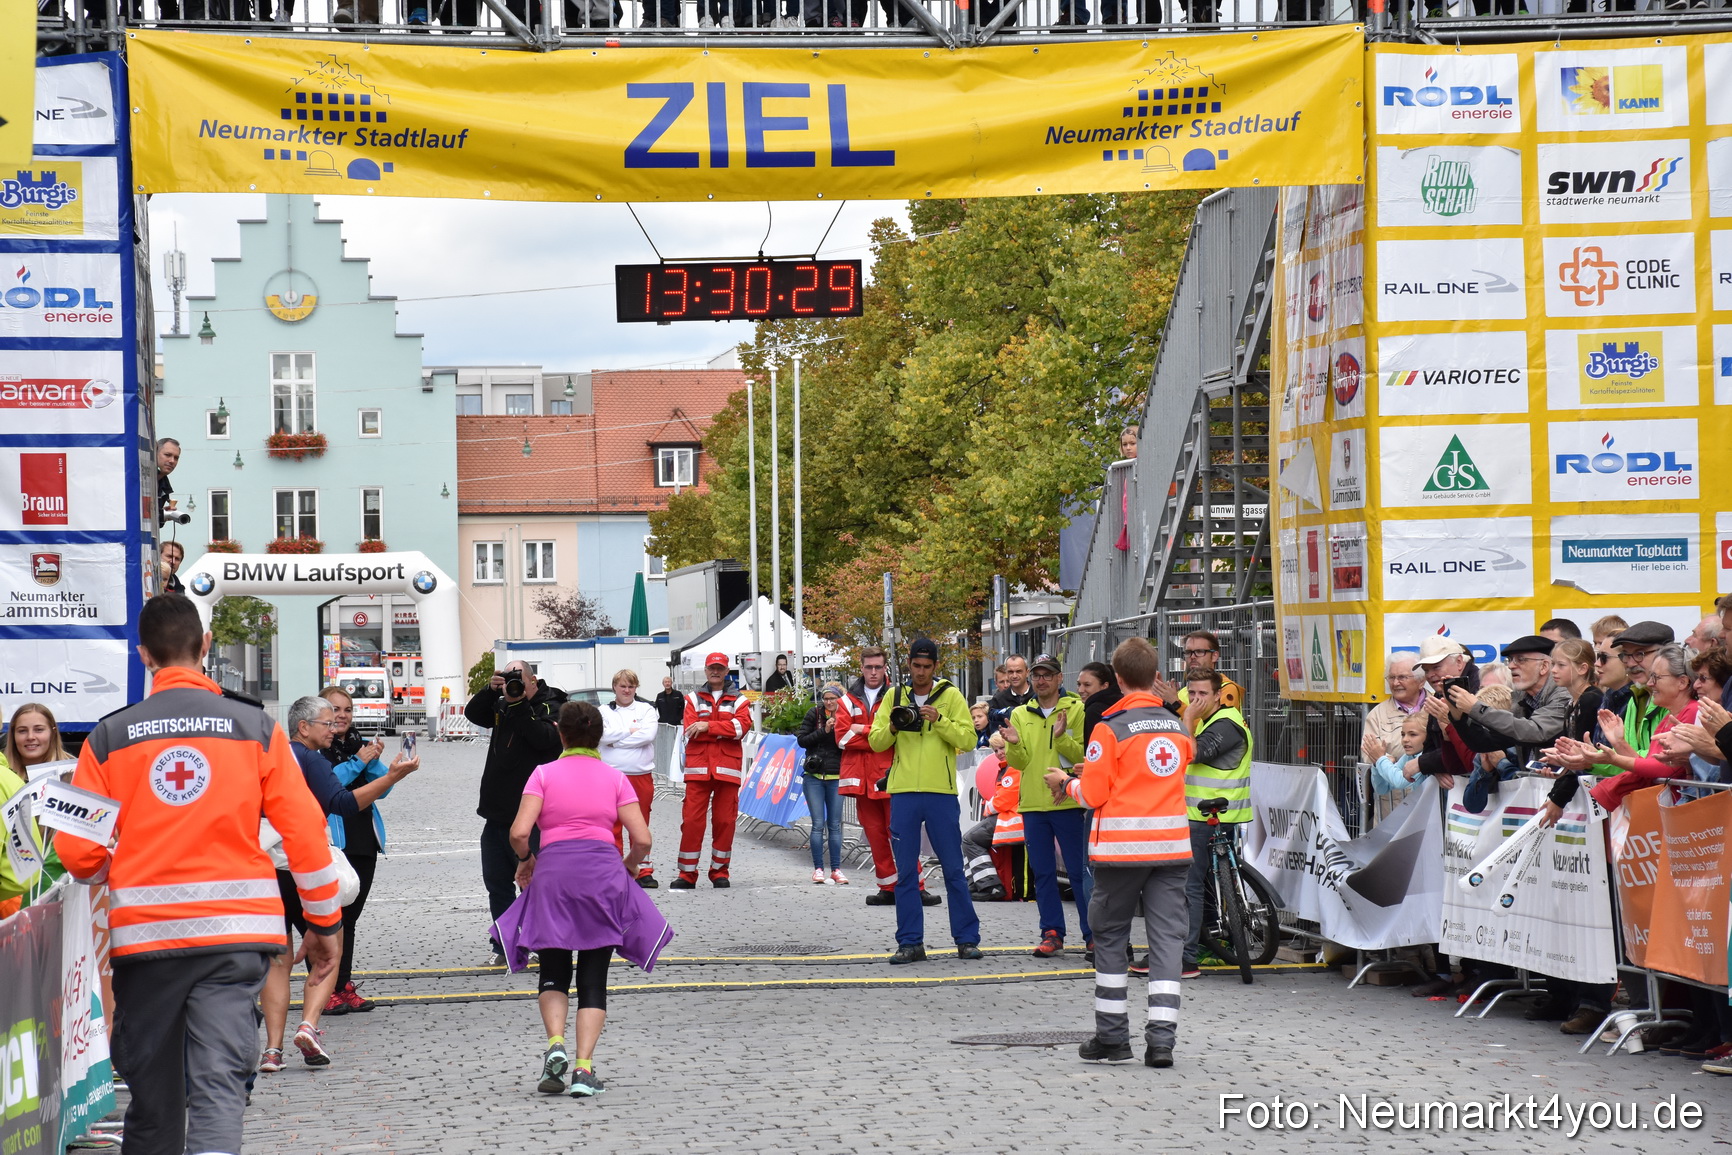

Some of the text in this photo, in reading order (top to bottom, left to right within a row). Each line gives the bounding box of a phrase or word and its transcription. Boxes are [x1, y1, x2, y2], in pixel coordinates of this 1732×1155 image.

[1452, 102, 1513, 118] energie
[1619, 97, 1659, 109] KANN
[624, 82, 895, 168] ZIEL
[1044, 111, 1301, 145] Neumarkter Stadtlauf
[199, 120, 469, 148] Neumarkter Stadtlauf
[1424, 155, 1471, 188] RUND
[1547, 169, 1636, 194] swn
[0, 182, 77, 209] Burgis
[1424, 186, 1478, 214] SCHAU
[1547, 194, 1660, 206] stadtwerke neumarkt
[1626, 259, 1671, 273] CODE
[1384, 282, 1479, 295] RAIL.ONE
[1626, 274, 1680, 289] CLINIC
[44, 309, 112, 324] energie
[1588, 351, 1658, 380] Burgis
[1423, 369, 1521, 385] VARIOTEC
[0, 384, 75, 401] arivari
[1590, 387, 1655, 396] Kartoffelspezialitäten
[1627, 471, 1692, 487] energie
[21, 493, 65, 511] Braun
[1457, 492, 1474, 500] Service
[1475, 491, 1490, 499] GmbH
[1567, 544, 1683, 559] Neumarkter Tagblatt
[223, 561, 405, 585] BMW Laufsport
[1390, 561, 1486, 575] RAIL.ONE
[1631, 562, 1688, 572] Hier lebe ich.
[10, 591, 85, 602] Neumarkter
[127, 716, 232, 739] BEREITSCHAFTEN
[1149, 740, 1176, 754] DEUTSCHES
[155, 750, 204, 772] DEUTSCHES
[1149, 756, 1179, 774] ROTES KREUZ
[154, 775, 206, 802] ROTES KREUZ
[45, 797, 89, 819] swn
[1690, 826, 1724, 842] Partner
[1619, 831, 1662, 860] ODE
